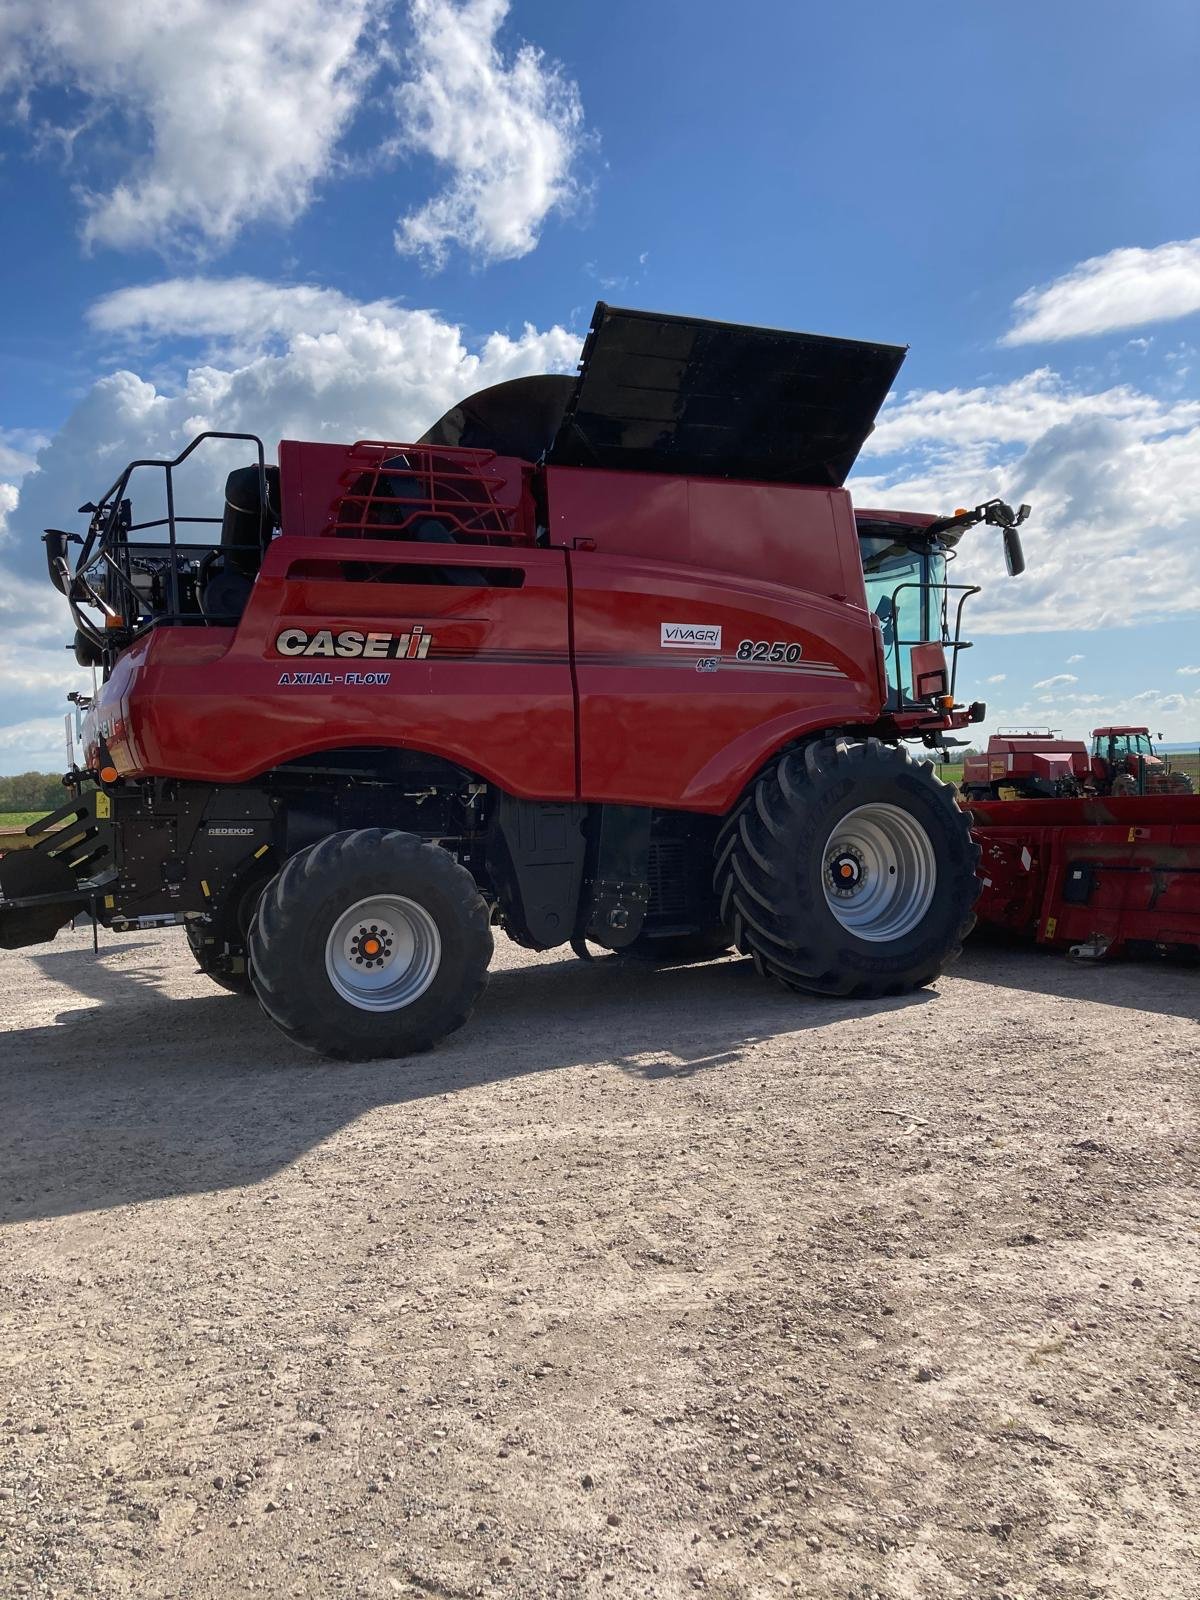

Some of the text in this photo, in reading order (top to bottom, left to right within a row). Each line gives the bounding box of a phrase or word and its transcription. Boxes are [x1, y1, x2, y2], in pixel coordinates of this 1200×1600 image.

[275, 628, 393, 658] CASE
[737, 640, 802, 663] 8250
[696, 658, 717, 668] AFS
[278, 672, 391, 686] AXIAL-FLOW
